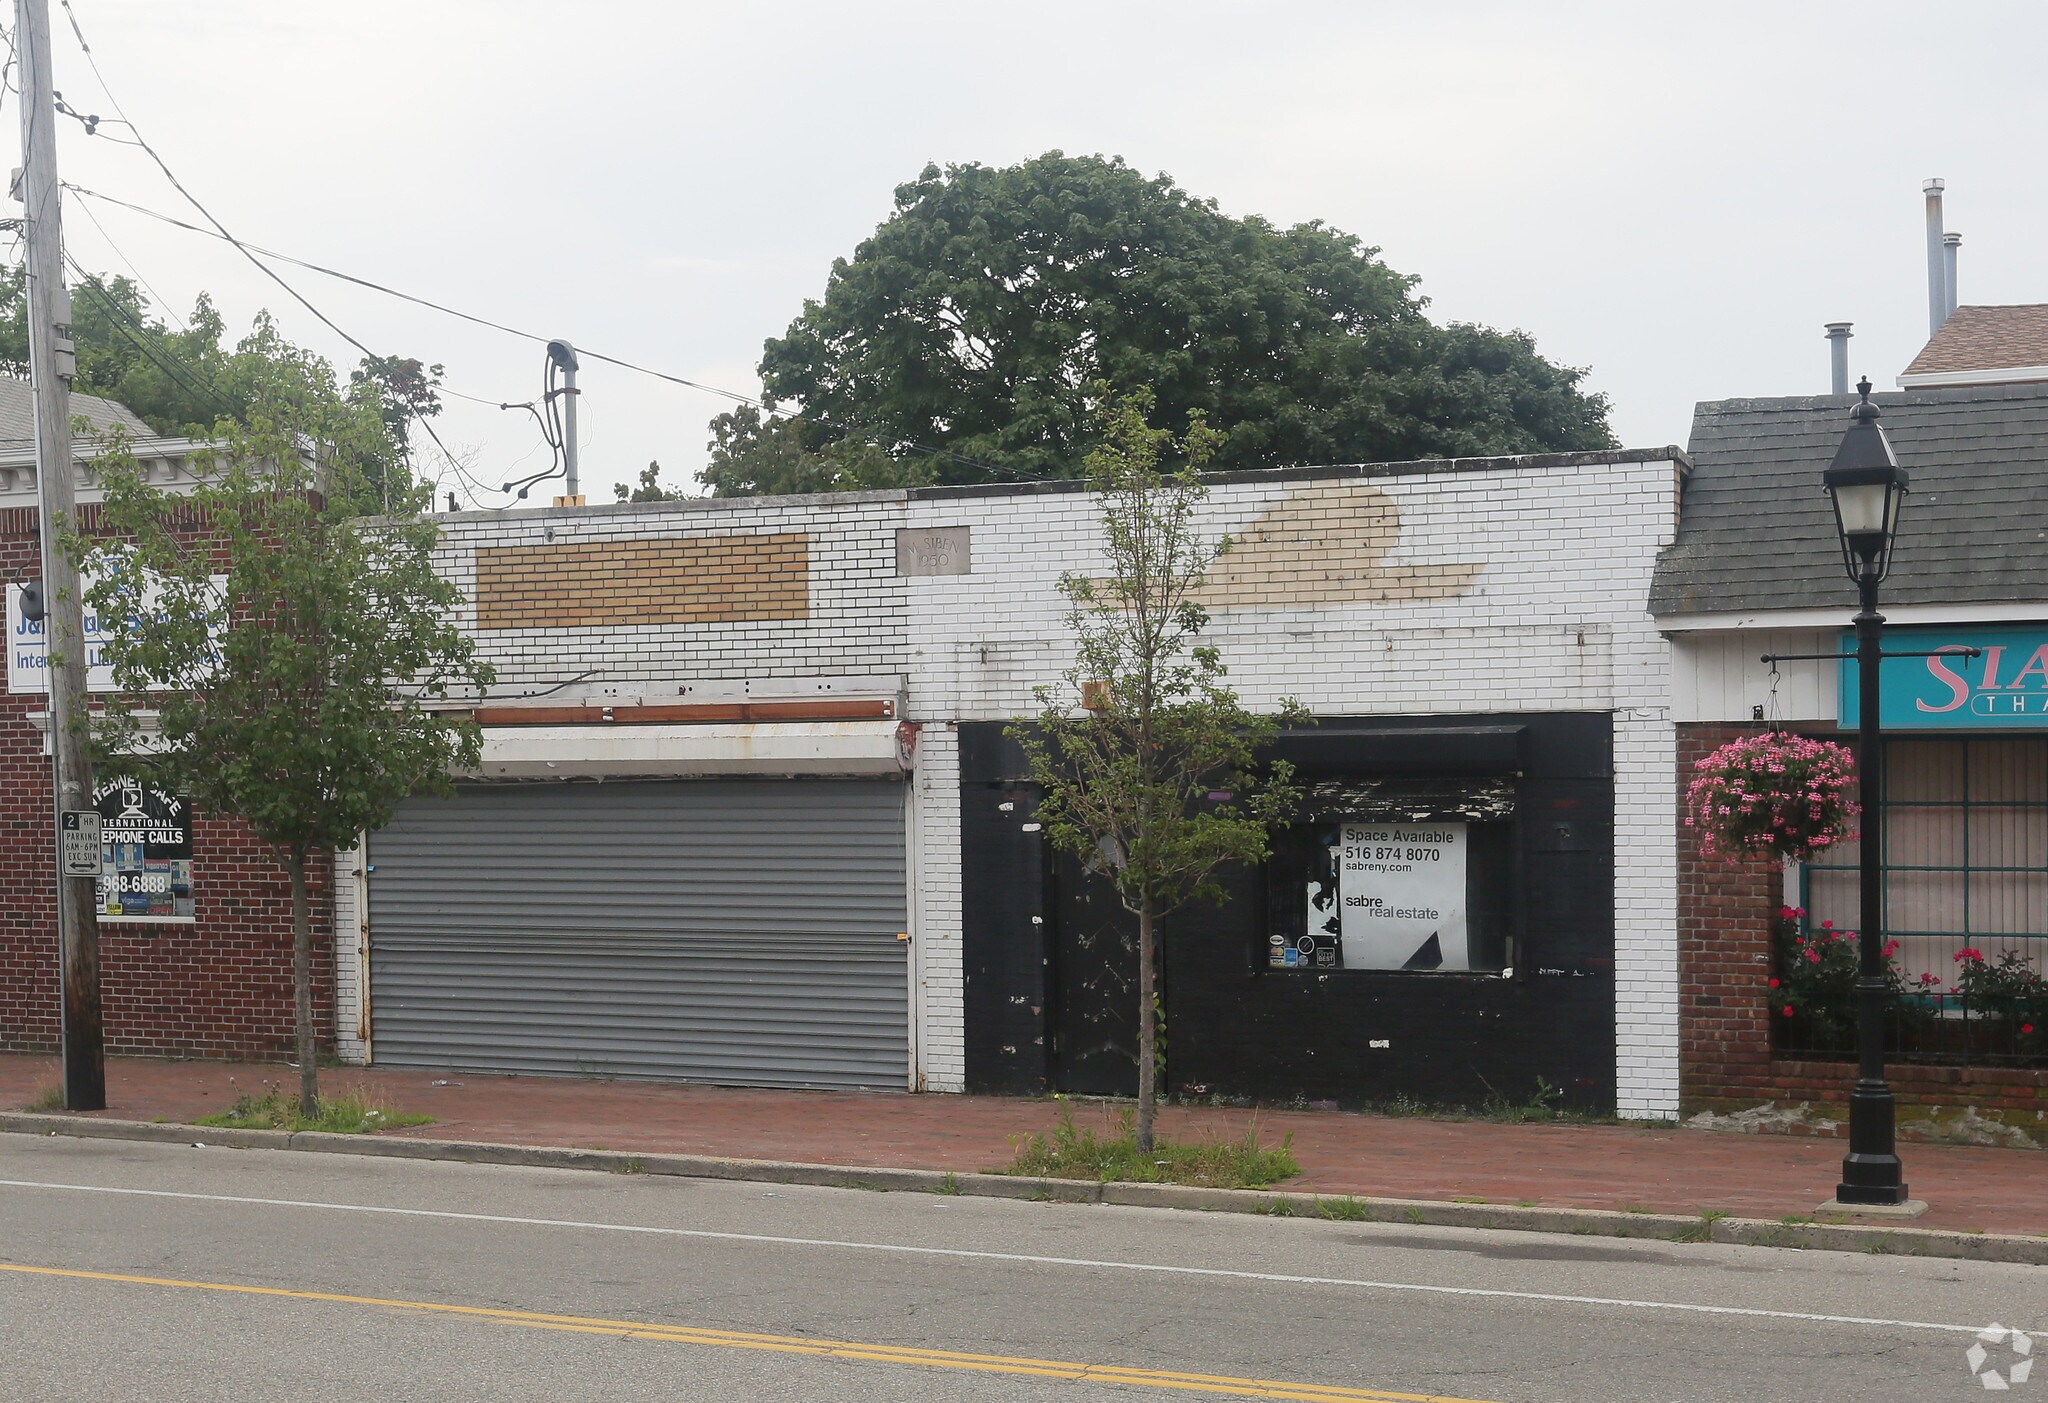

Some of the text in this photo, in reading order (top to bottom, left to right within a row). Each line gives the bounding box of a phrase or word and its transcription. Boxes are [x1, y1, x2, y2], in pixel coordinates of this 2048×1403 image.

[923, 537, 961, 553] SIBEN
[918, 554, 949, 567] 1950
[67, 815, 94, 827] 2 HR
[102, 819, 173, 827] TERNATIONAL
[66, 832, 97, 841] PARKING
[102, 831, 183, 844] EPHONE CALLS
[1345, 828, 1454, 844] Space Available
[68, 852, 97, 861] EXC SUN
[1345, 846, 1440, 861] 516 874 8070
[1345, 861, 1412, 873] sabreny.com
[1345, 894, 1383, 907] sabre
[1369, 905, 1439, 920] real estate
